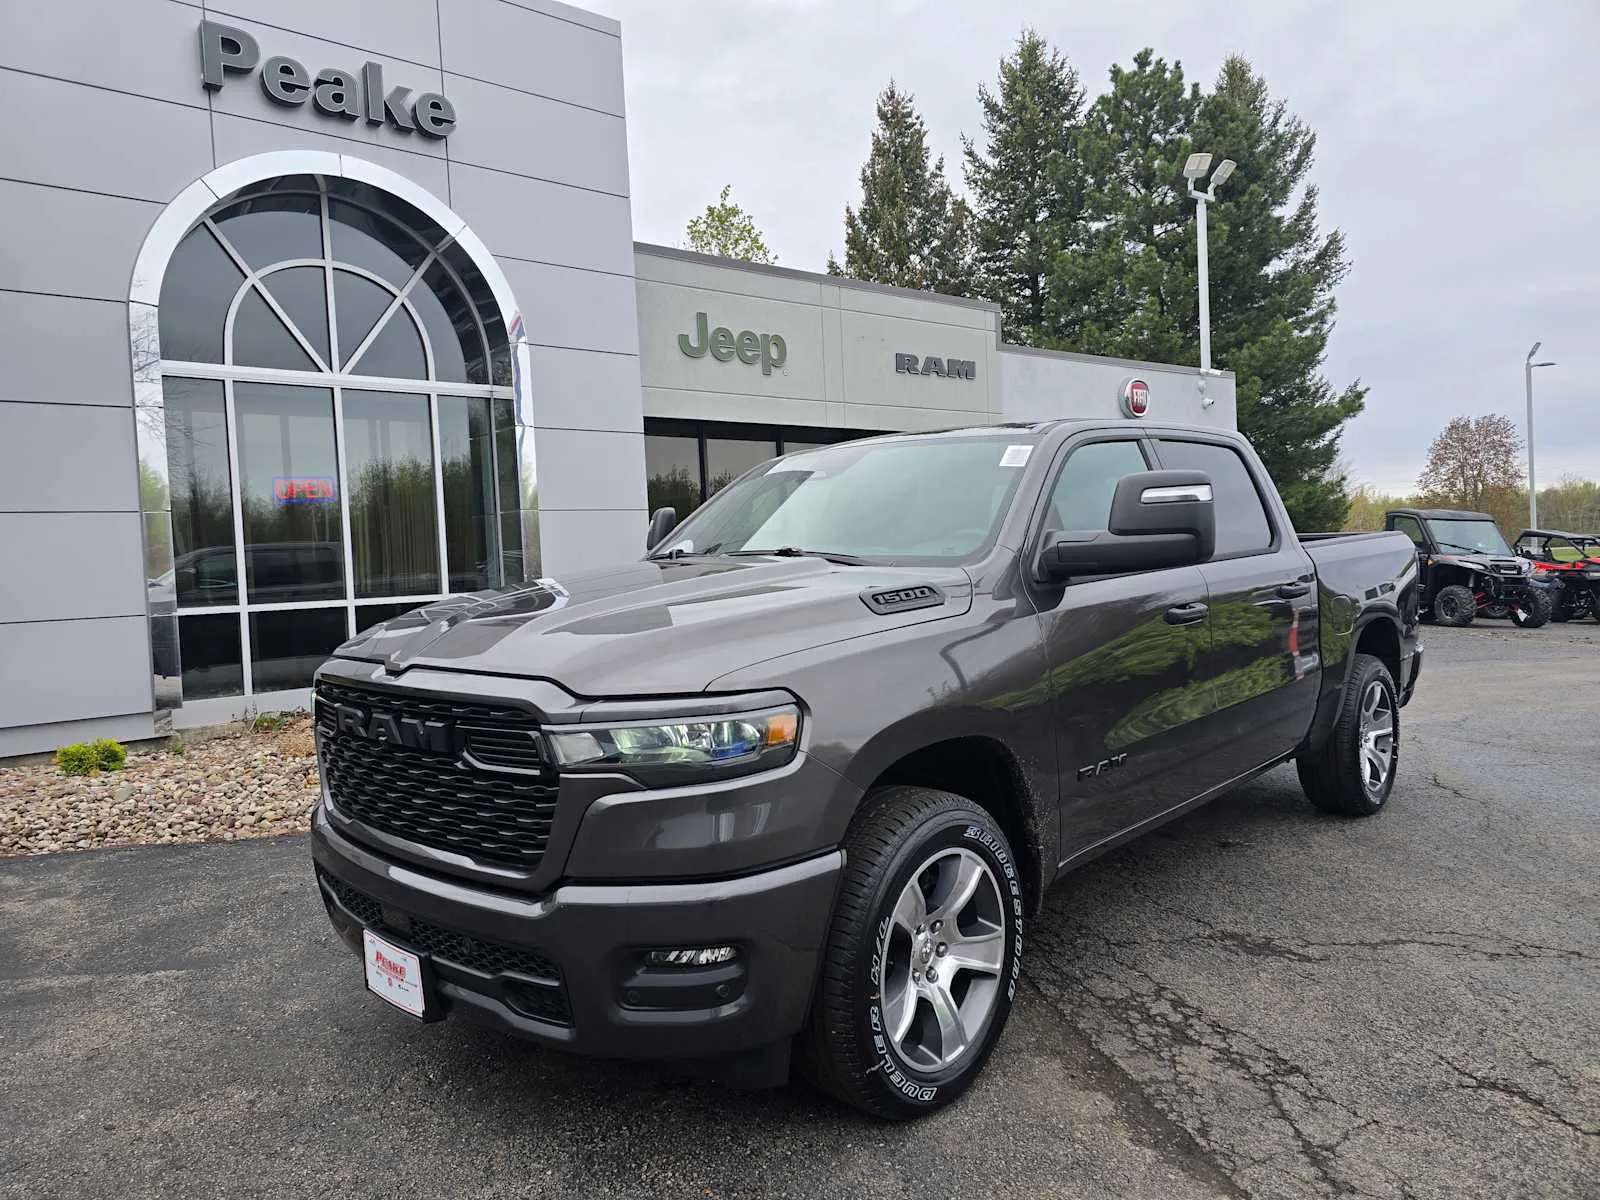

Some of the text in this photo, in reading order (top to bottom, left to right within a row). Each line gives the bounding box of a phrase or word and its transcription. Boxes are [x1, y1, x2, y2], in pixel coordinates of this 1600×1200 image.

[198, 19, 456, 139] Peake
[678, 312, 787, 375] Jeep
[896, 352, 976, 380] RAM
[274, 479, 334, 499] OPEN
[872, 587, 931, 605] 1500
[335, 703, 455, 753] RAM
[870, 1005, 938, 1101] DUELER
